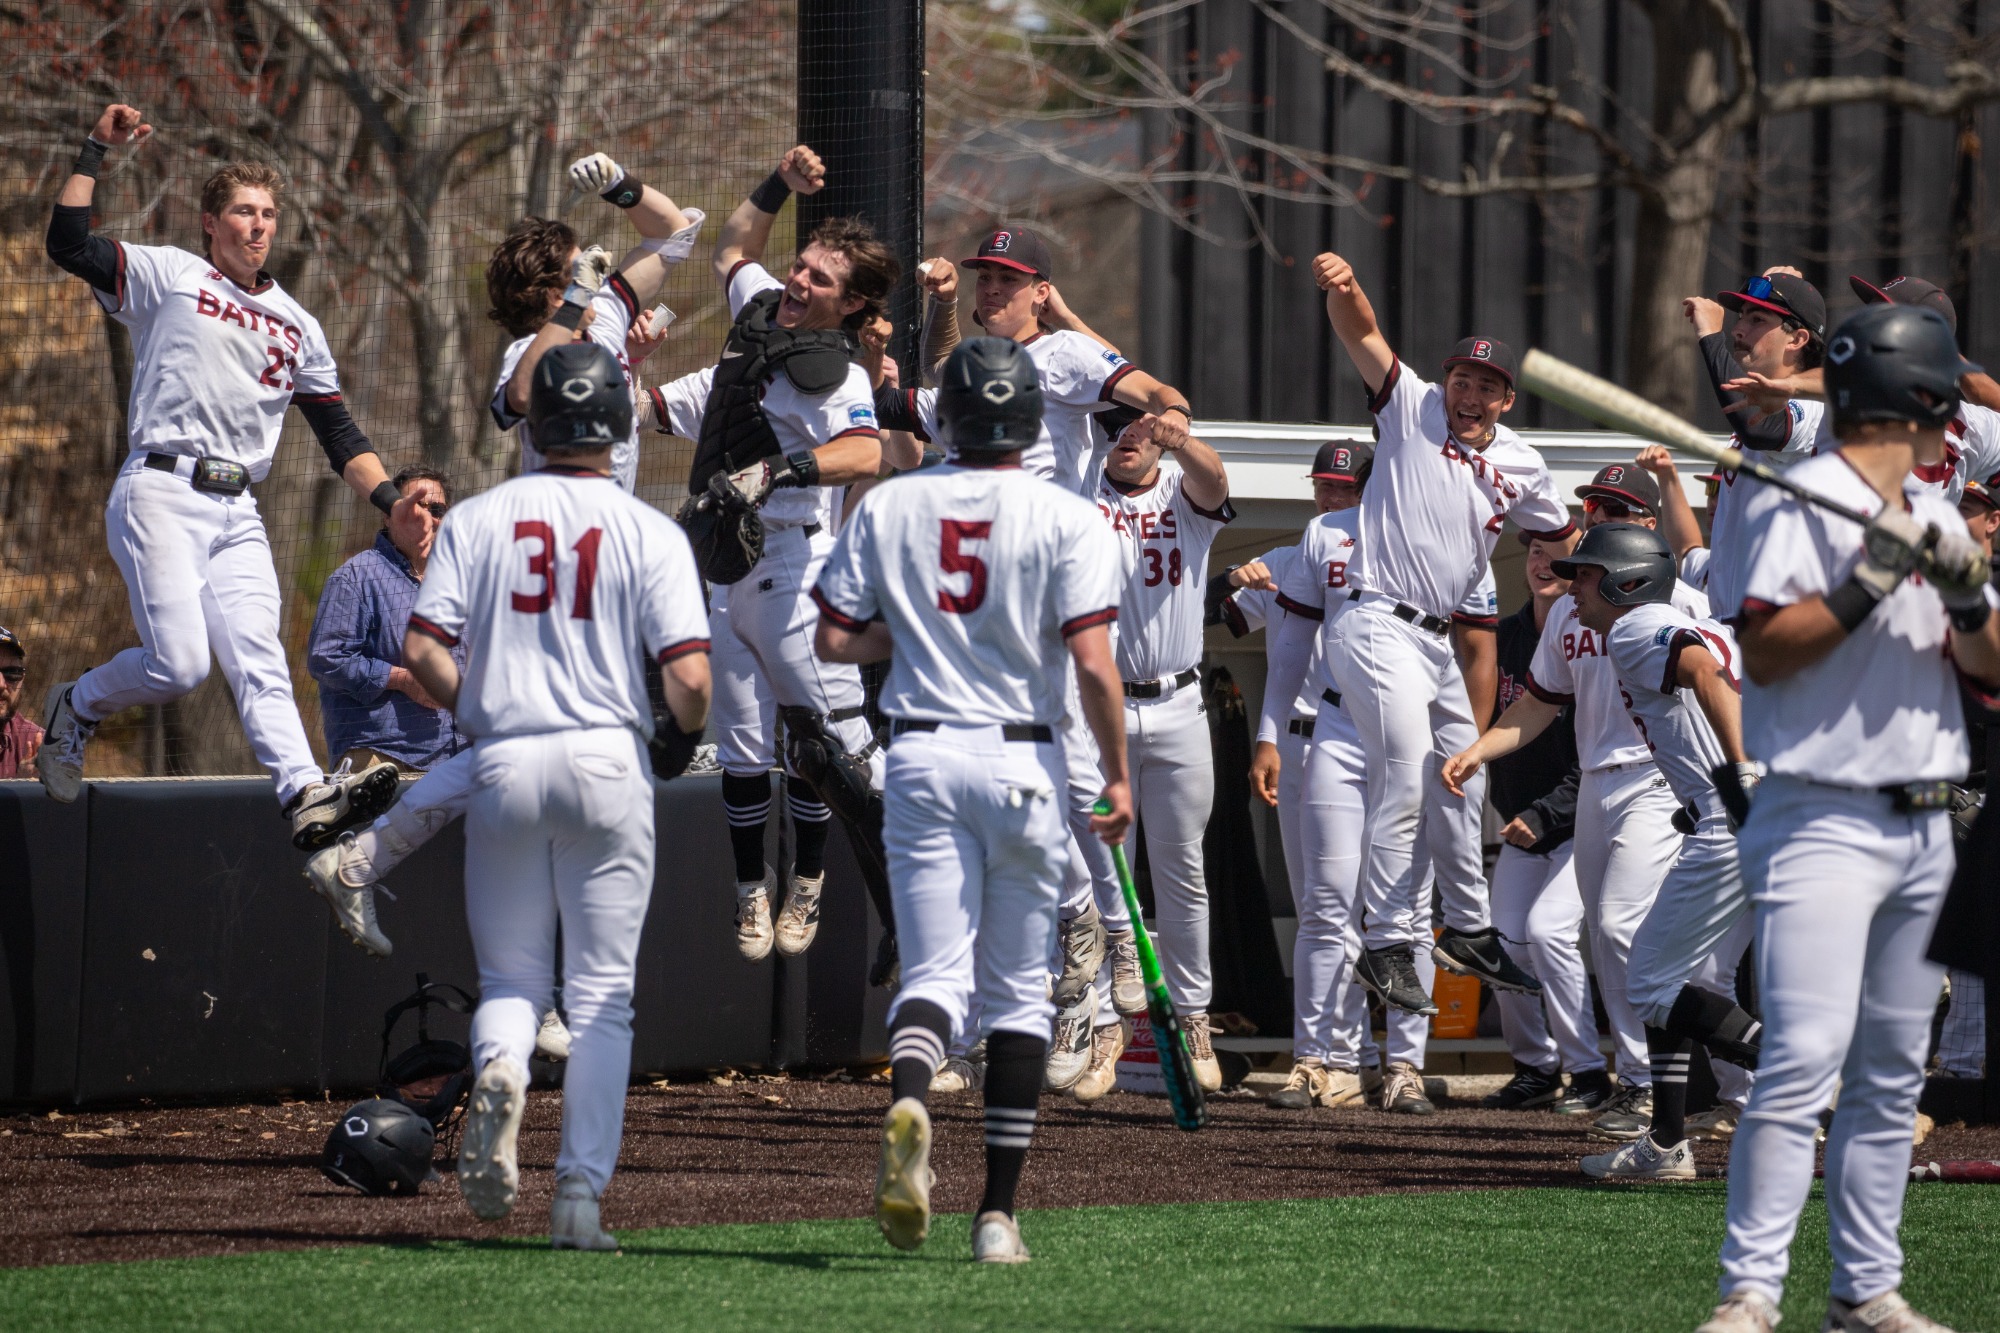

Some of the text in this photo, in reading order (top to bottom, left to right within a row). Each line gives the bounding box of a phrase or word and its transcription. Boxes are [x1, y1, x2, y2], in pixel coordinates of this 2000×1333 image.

[989, 231, 1012, 252] B
[196, 287, 303, 355] BATES
[1470, 340, 1492, 361] B
[1331, 448, 1351, 470] B
[1602, 466, 1625, 485] B
[511, 519, 603, 621] 31
[937, 518, 994, 615] 5
[1143, 547, 1182, 588] 38
